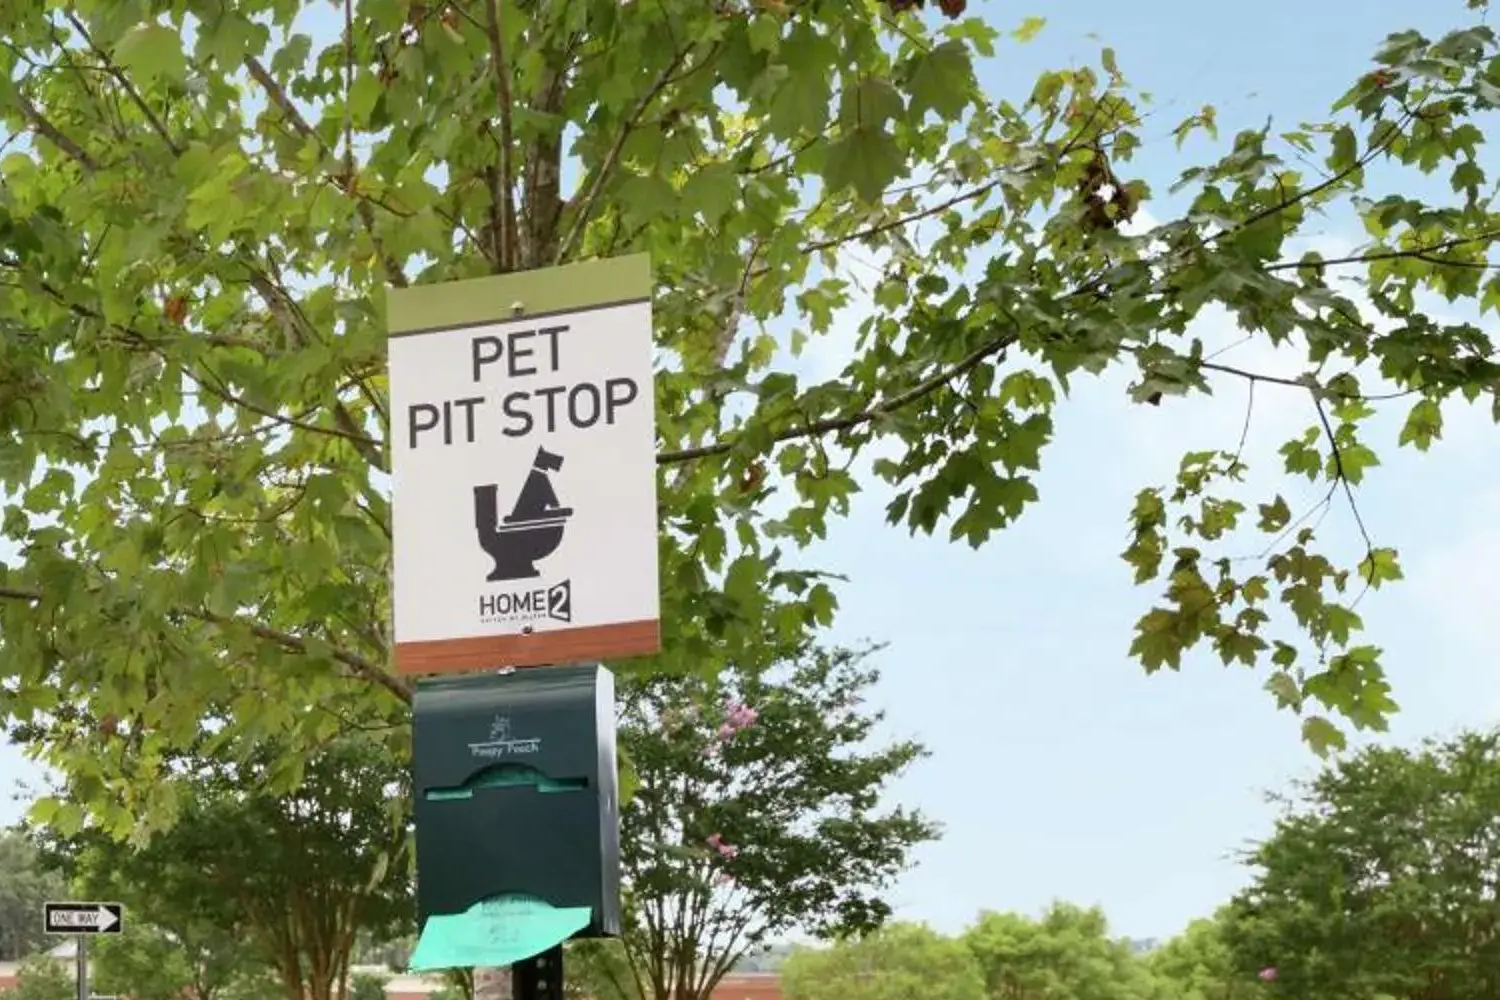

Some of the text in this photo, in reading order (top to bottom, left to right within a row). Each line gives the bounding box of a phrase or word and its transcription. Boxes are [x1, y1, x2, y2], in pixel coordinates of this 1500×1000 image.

[472, 325, 570, 382] PET
[408, 377, 639, 449] PIT STOP
[53, 911, 99, 925] ONE WAY
